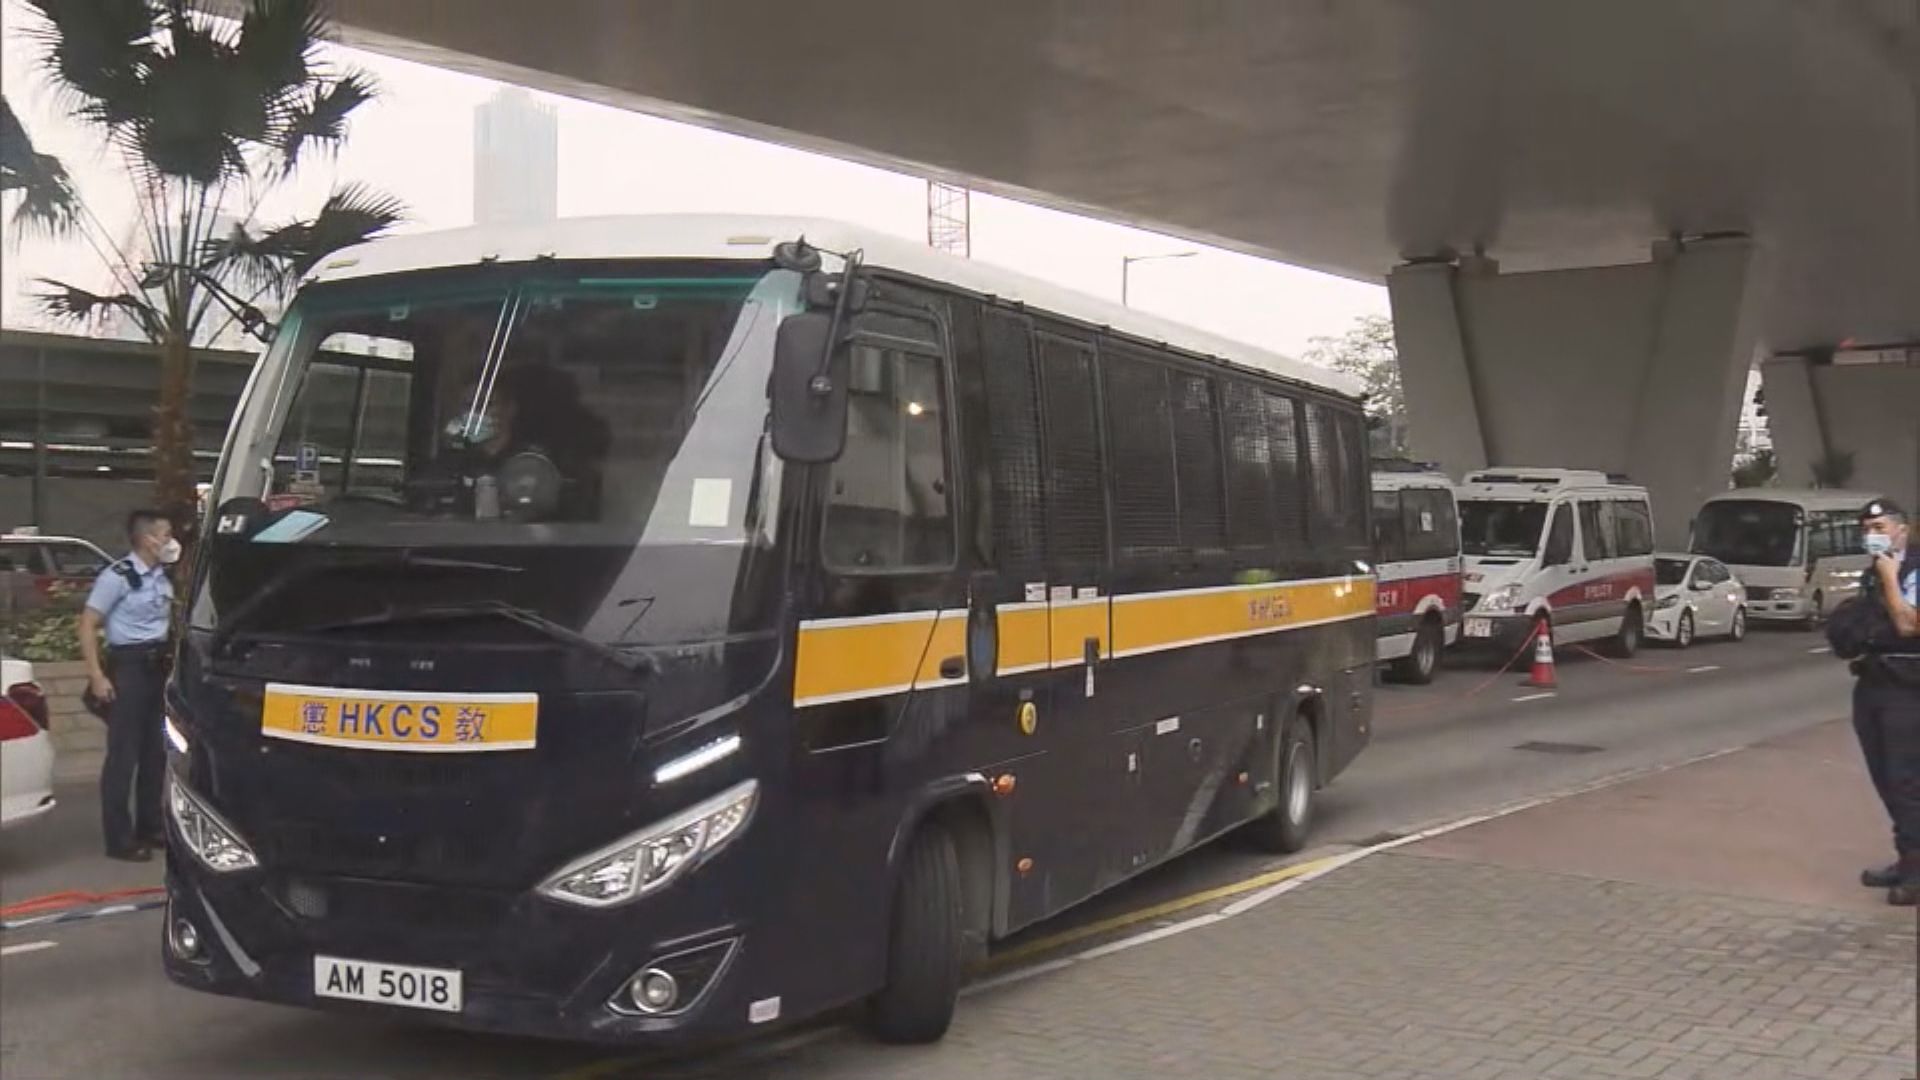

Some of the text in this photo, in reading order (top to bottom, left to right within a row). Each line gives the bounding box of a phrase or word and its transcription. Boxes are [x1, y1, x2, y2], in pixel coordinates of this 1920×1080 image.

[340, 703, 441, 738] HKCS
[327, 964, 449, 1003] AM 5018
